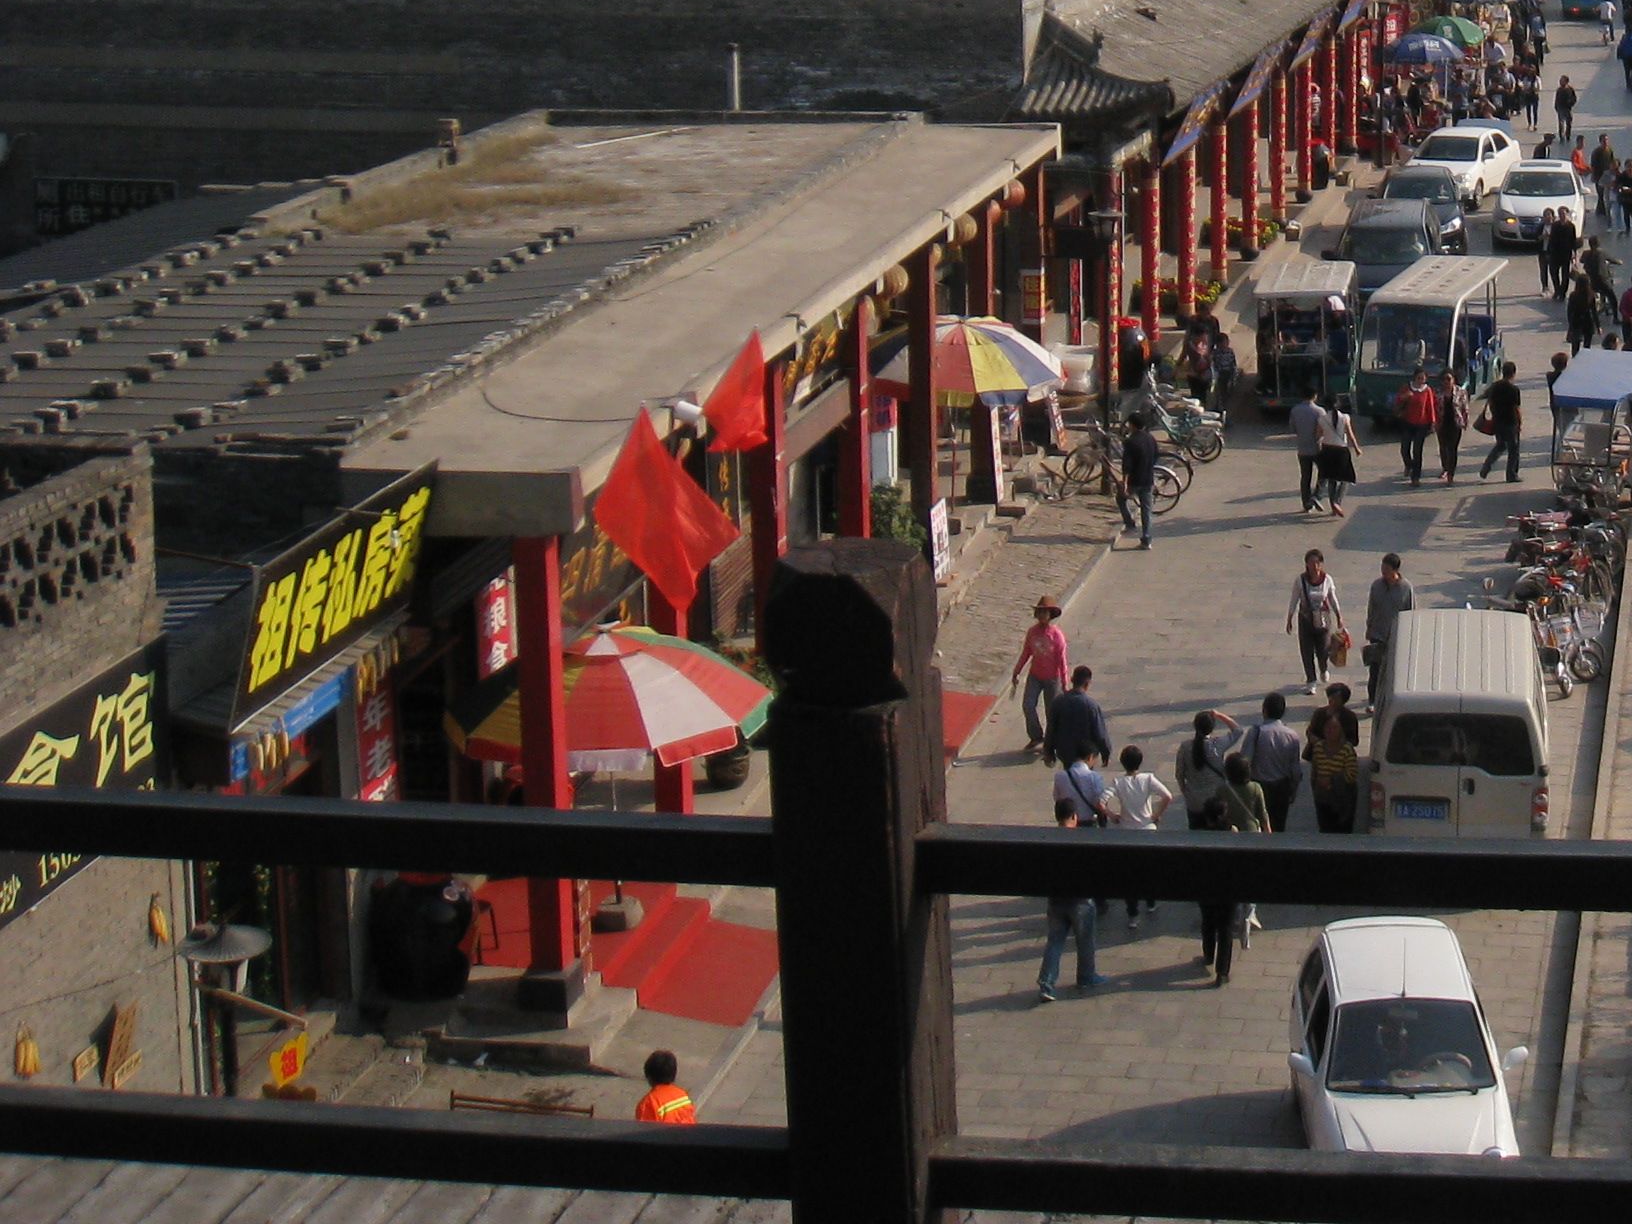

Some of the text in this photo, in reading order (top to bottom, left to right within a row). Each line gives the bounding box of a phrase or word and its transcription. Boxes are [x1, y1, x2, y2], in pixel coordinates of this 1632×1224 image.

[248, 486, 431, 693] 祖传私房菜
